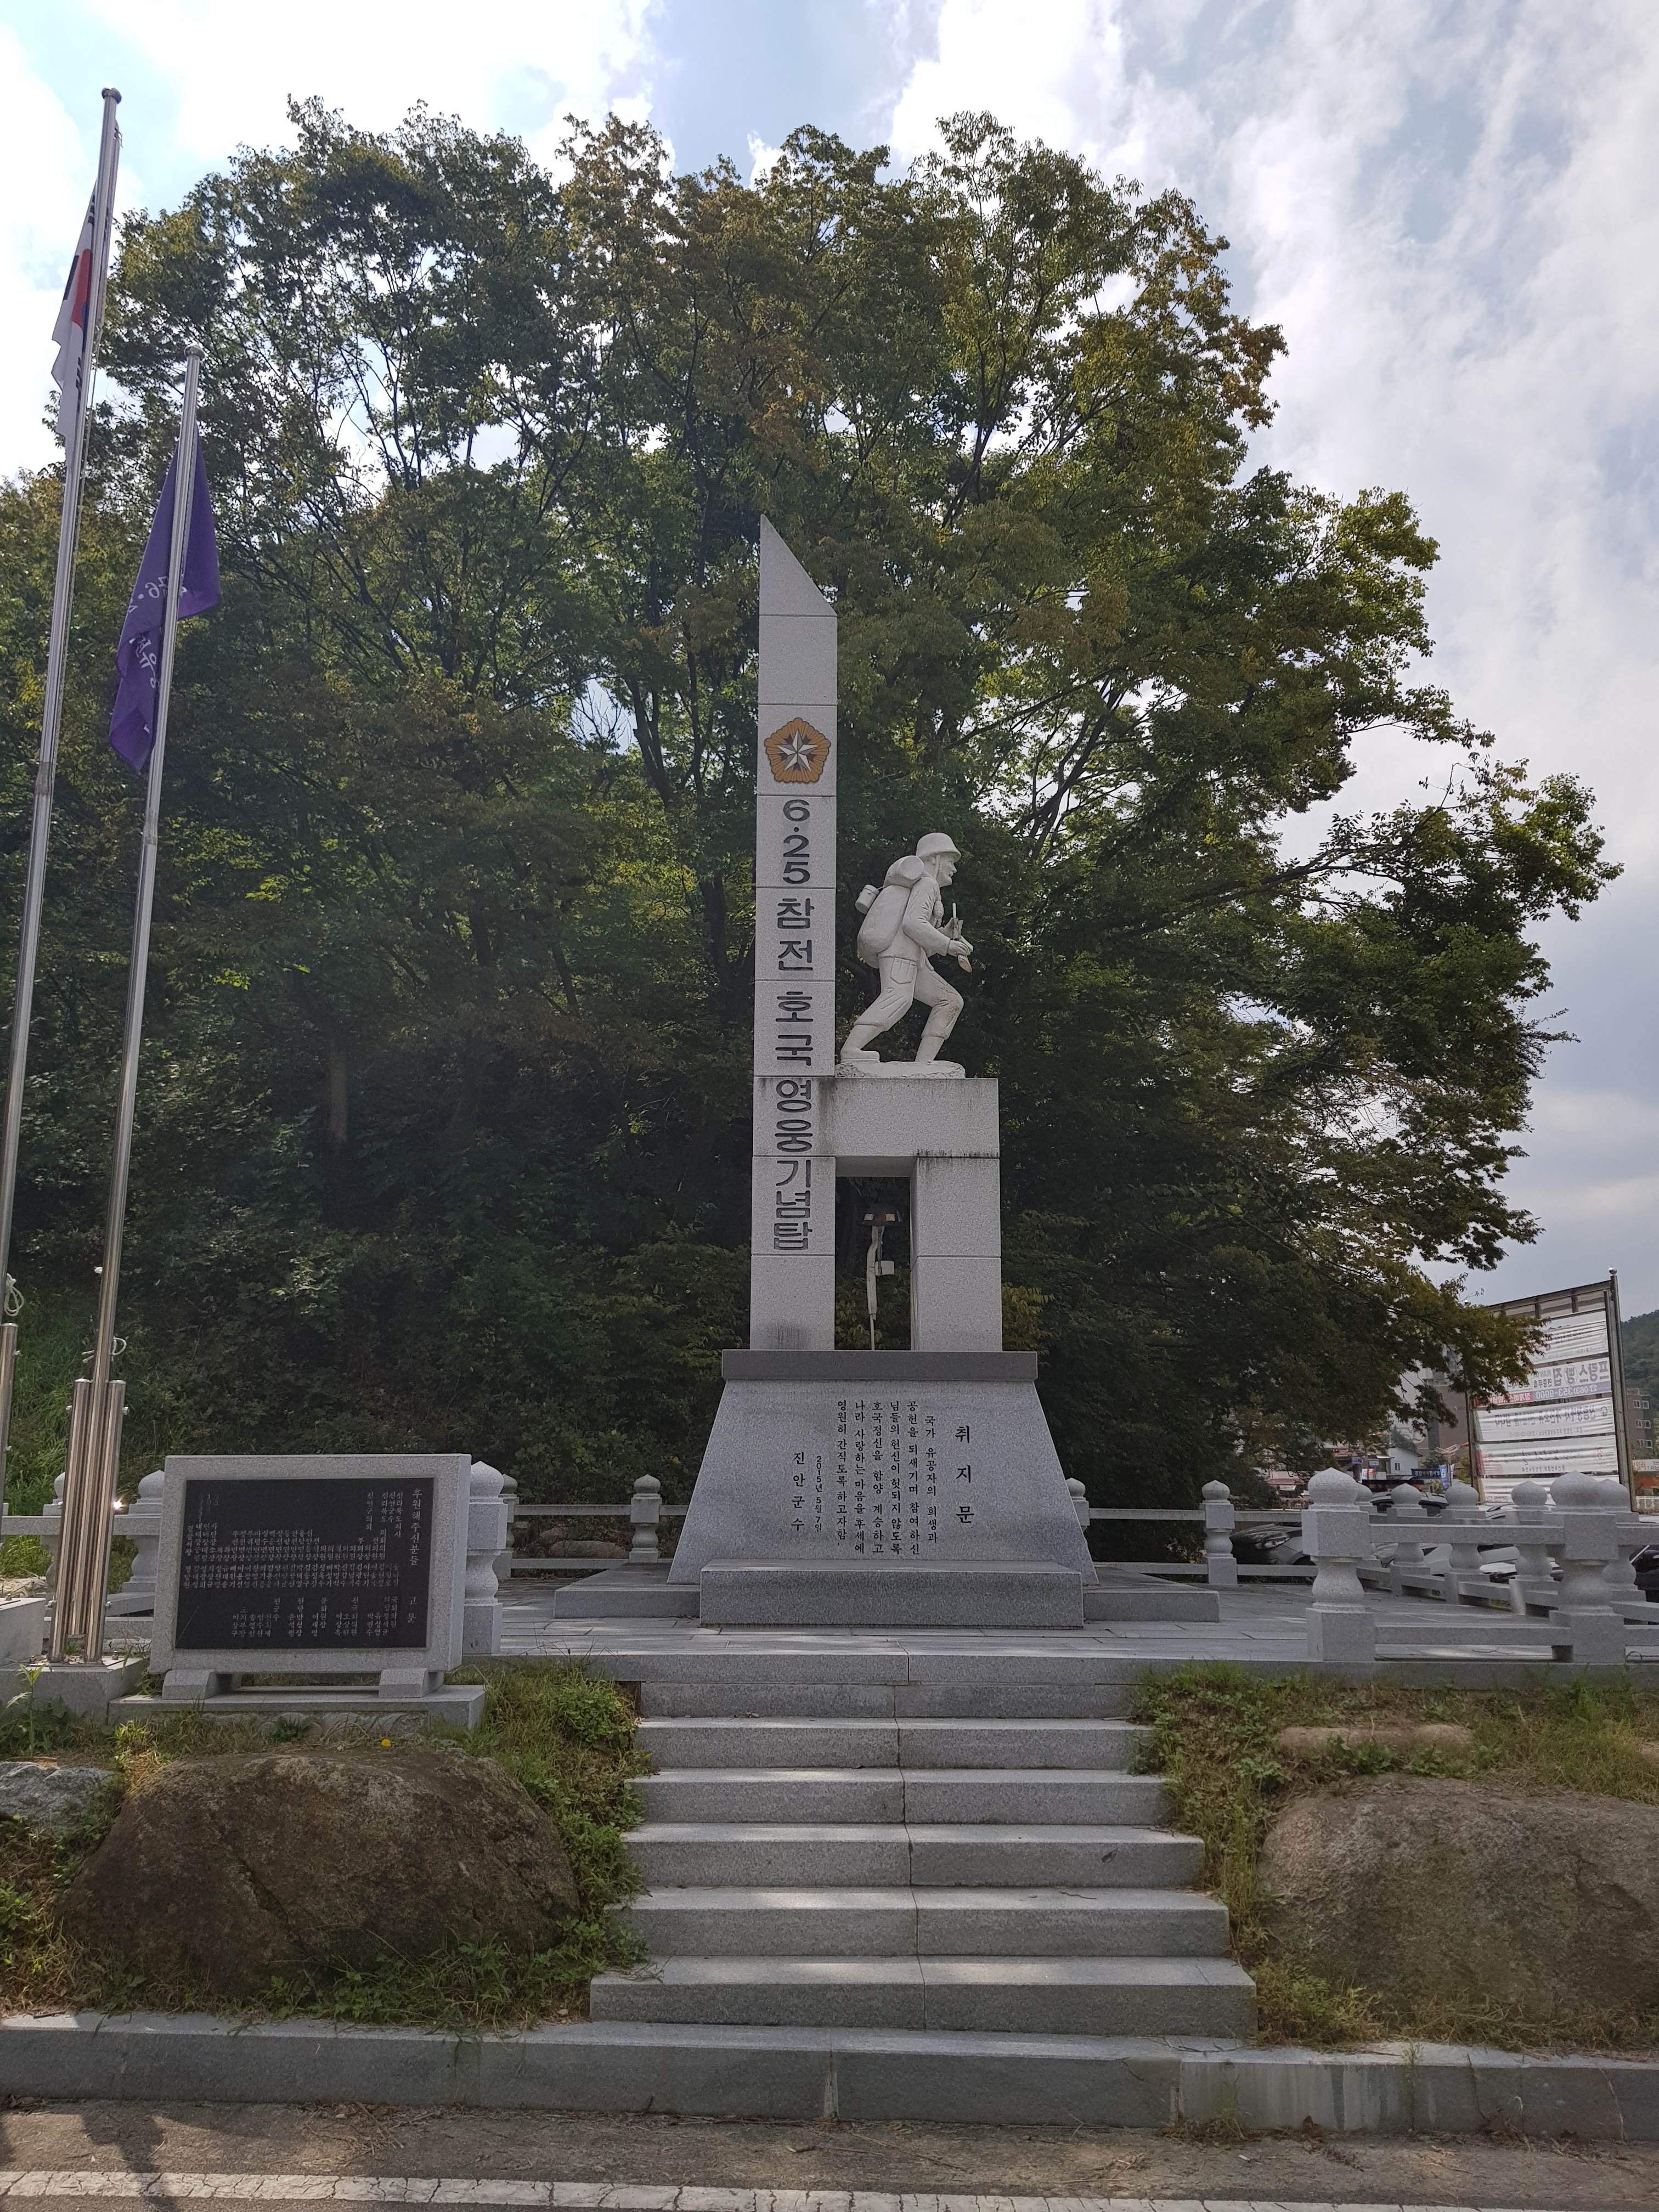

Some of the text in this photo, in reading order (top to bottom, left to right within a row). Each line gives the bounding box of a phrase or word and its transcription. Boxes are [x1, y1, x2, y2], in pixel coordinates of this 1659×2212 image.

[837, 1400, 847, 1435] 영원히
[791, 1451, 805, 1532] 진안군수
[815, 1497, 822, 1514] 5월
[815, 1516, 822, 1532] 7일
[854, 1400, 865, 1554] 나라 사랑하는 마음을 후세에
[872, 1401, 884, 1553] 호국정신을 함양 계승하고
[890, 1401, 902, 1555] 님들의 헌신이 헛되지 않도록
[907, 1401, 920, 1555] 공헌을 되새기며 참여하신
[925, 1416, 938, 1543] 국가 유공자의 희생과
[955, 1425, 975, 1523] 취지문
